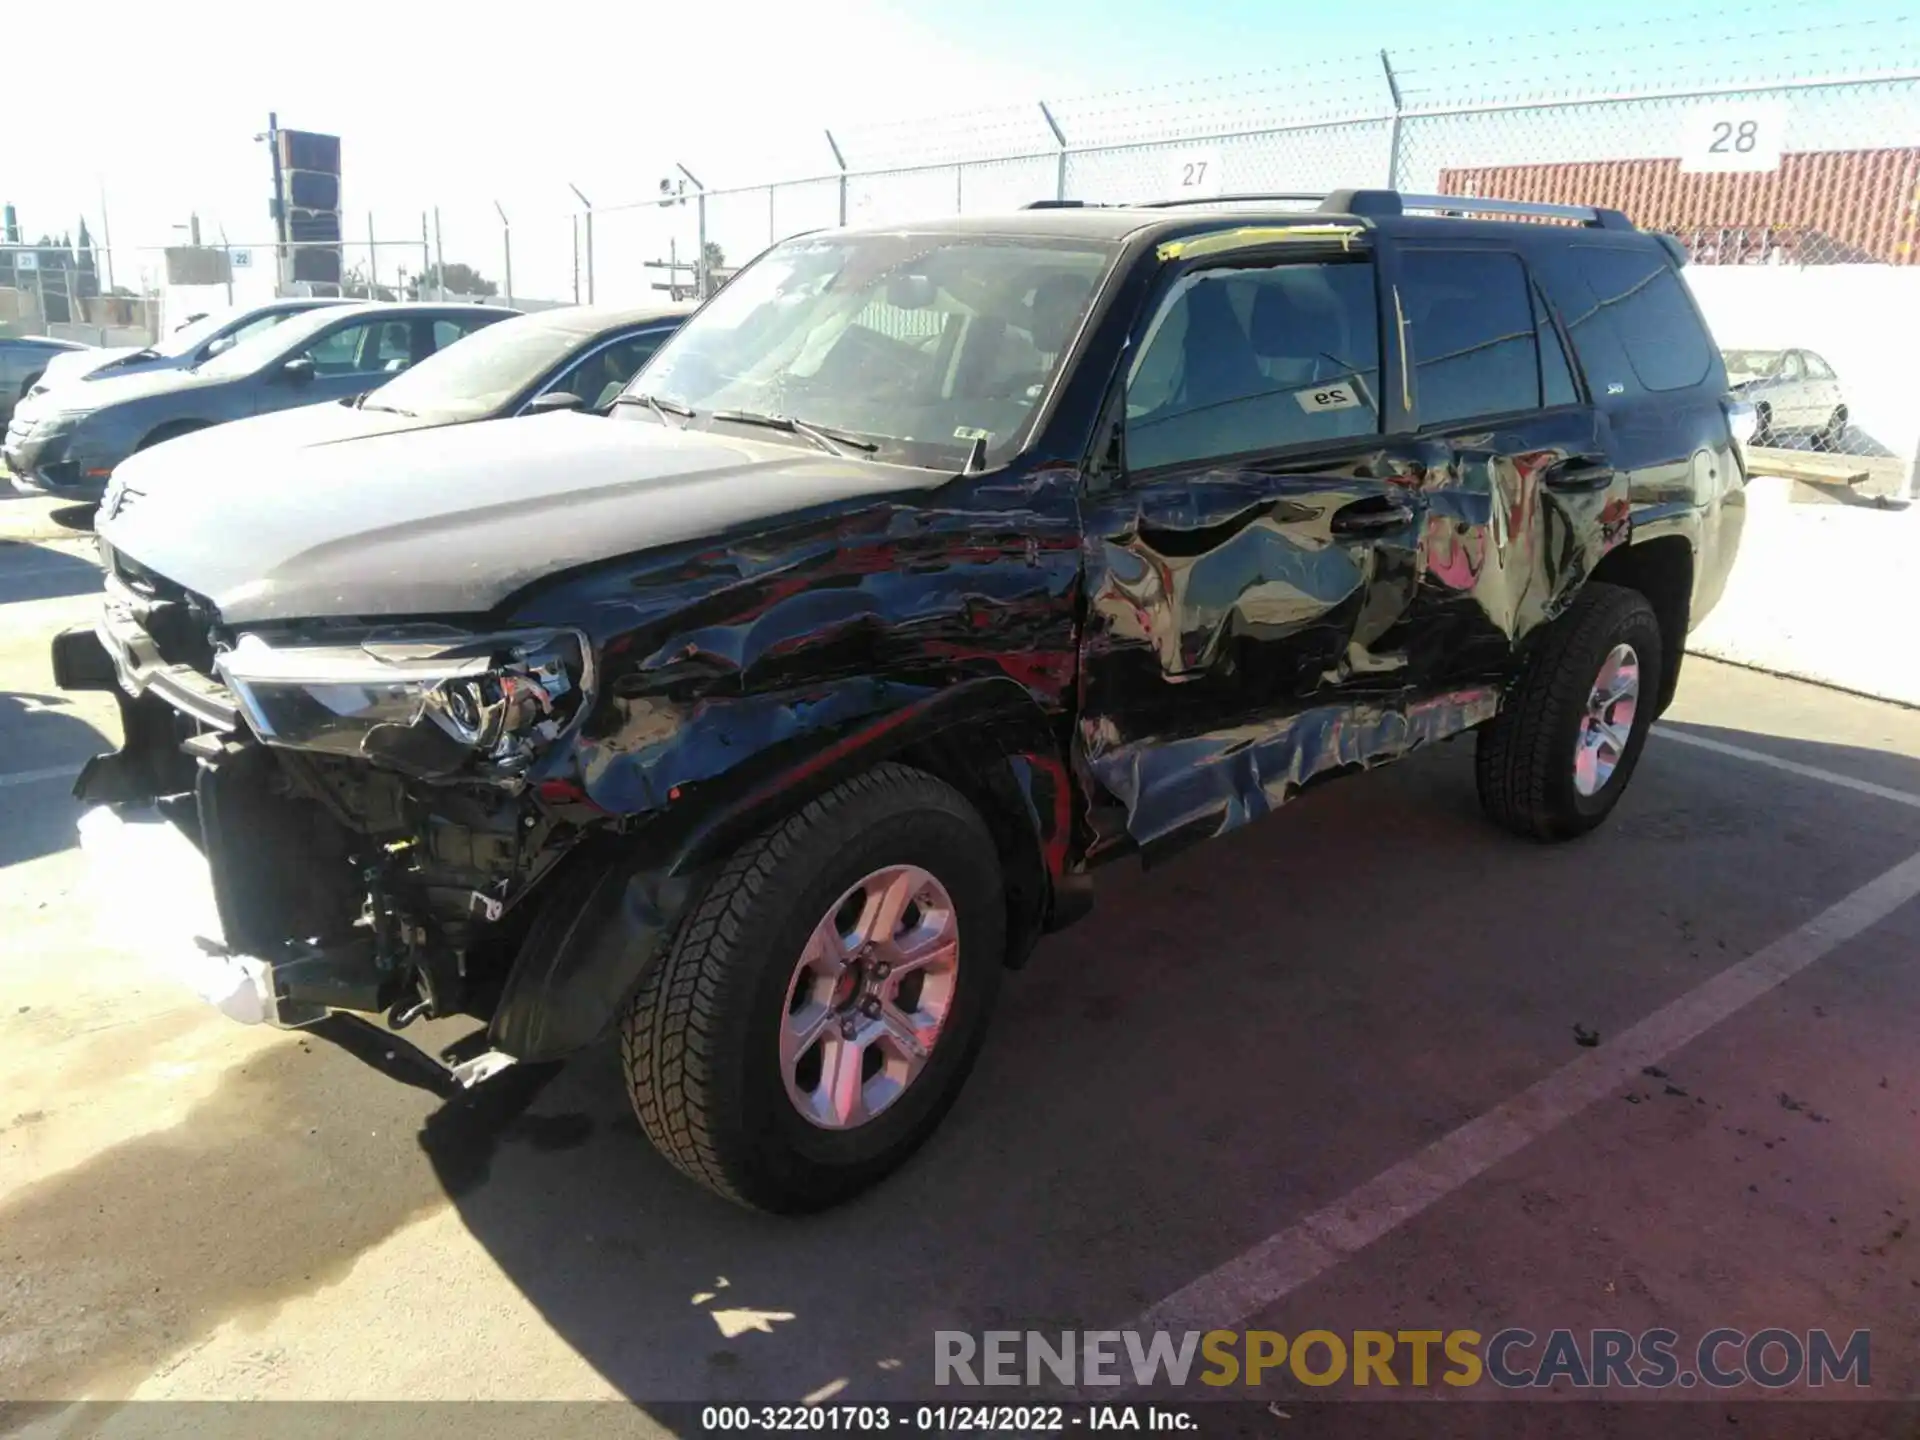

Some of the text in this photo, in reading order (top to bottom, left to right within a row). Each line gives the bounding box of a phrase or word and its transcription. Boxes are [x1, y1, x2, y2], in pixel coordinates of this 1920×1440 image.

[1708, 120, 1758, 153] 28
[1182, 161, 1208, 186] 27
[235, 253, 248, 265] 22
